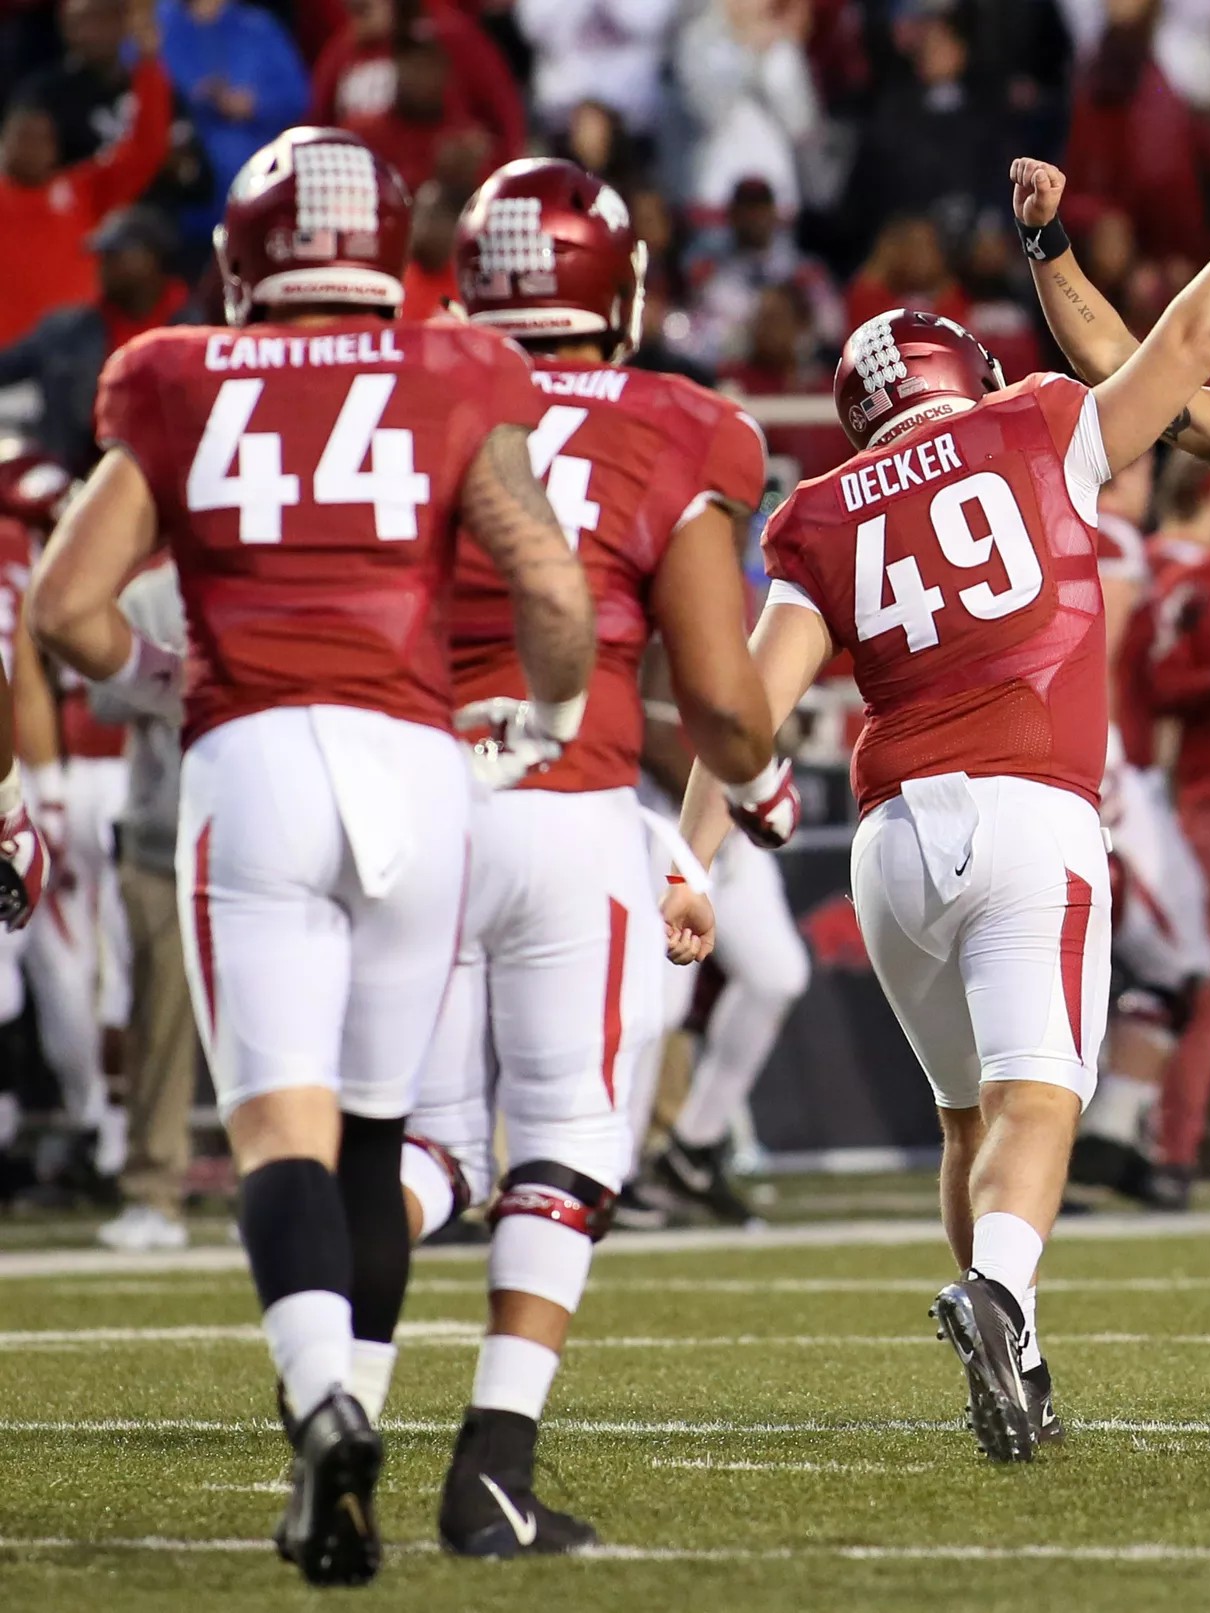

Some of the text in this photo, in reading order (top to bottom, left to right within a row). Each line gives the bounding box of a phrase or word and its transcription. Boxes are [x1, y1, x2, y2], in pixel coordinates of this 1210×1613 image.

[1077, 304, 1096, 323] XCI
[204, 328, 405, 372] CANTRELL
[530, 369, 630, 403] SON
[872, 403, 954, 448] ZORBACKS
[186, 372, 430, 545] 44
[840, 432, 963, 513] DECKER
[854, 471, 1044, 654] 49
